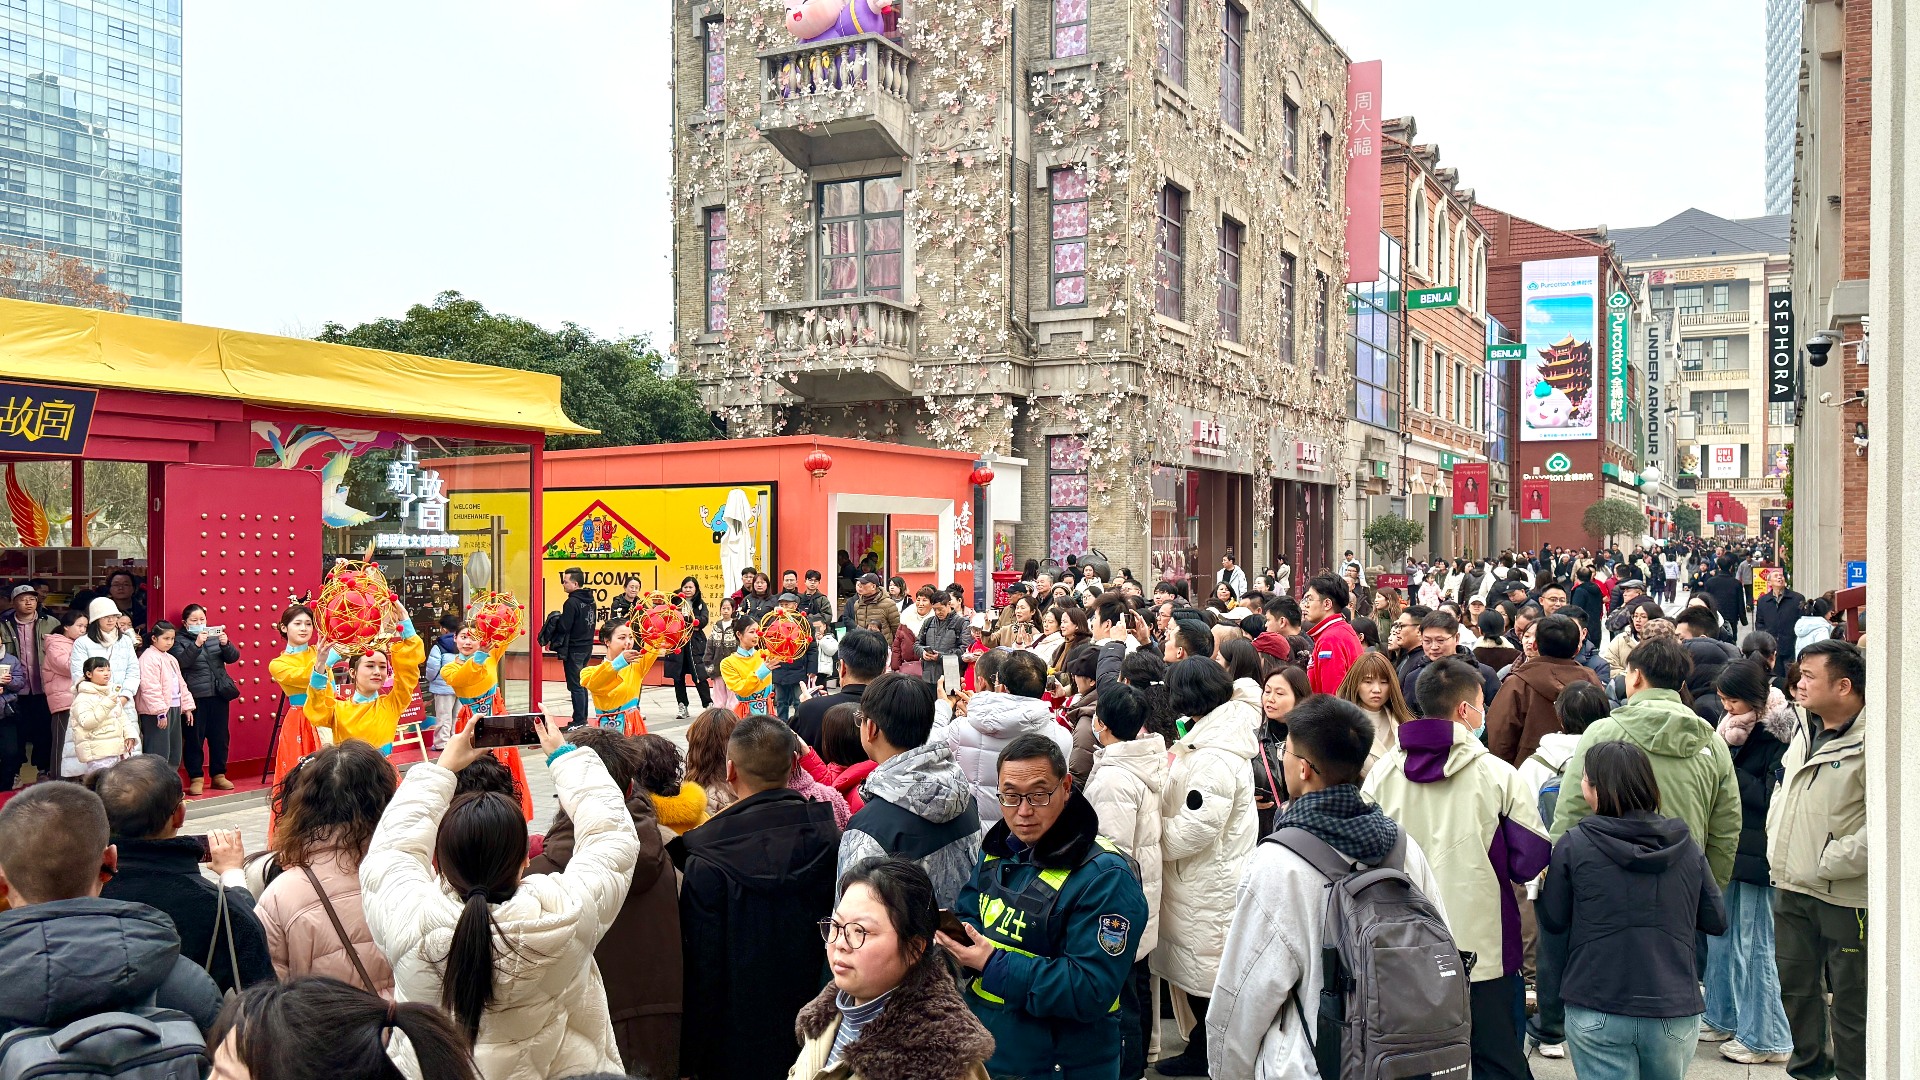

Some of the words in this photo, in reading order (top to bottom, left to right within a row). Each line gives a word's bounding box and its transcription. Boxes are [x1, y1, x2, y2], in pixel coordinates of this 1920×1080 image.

[1353, 91, 1372, 157] 周大福
[1420, 292, 1452, 304] BENLAI
[1490, 348, 1521, 358] BENLAI
[1611, 313, 1626, 376] Purcotton
[1648, 327, 1659, 382] UNDER
[1774, 298, 1790, 396] SEPHORA
[1610, 377, 1624, 422] 全棉时代
[1648, 384, 1659, 455] ARMOUR
[386, 443, 420, 518] 上新了
